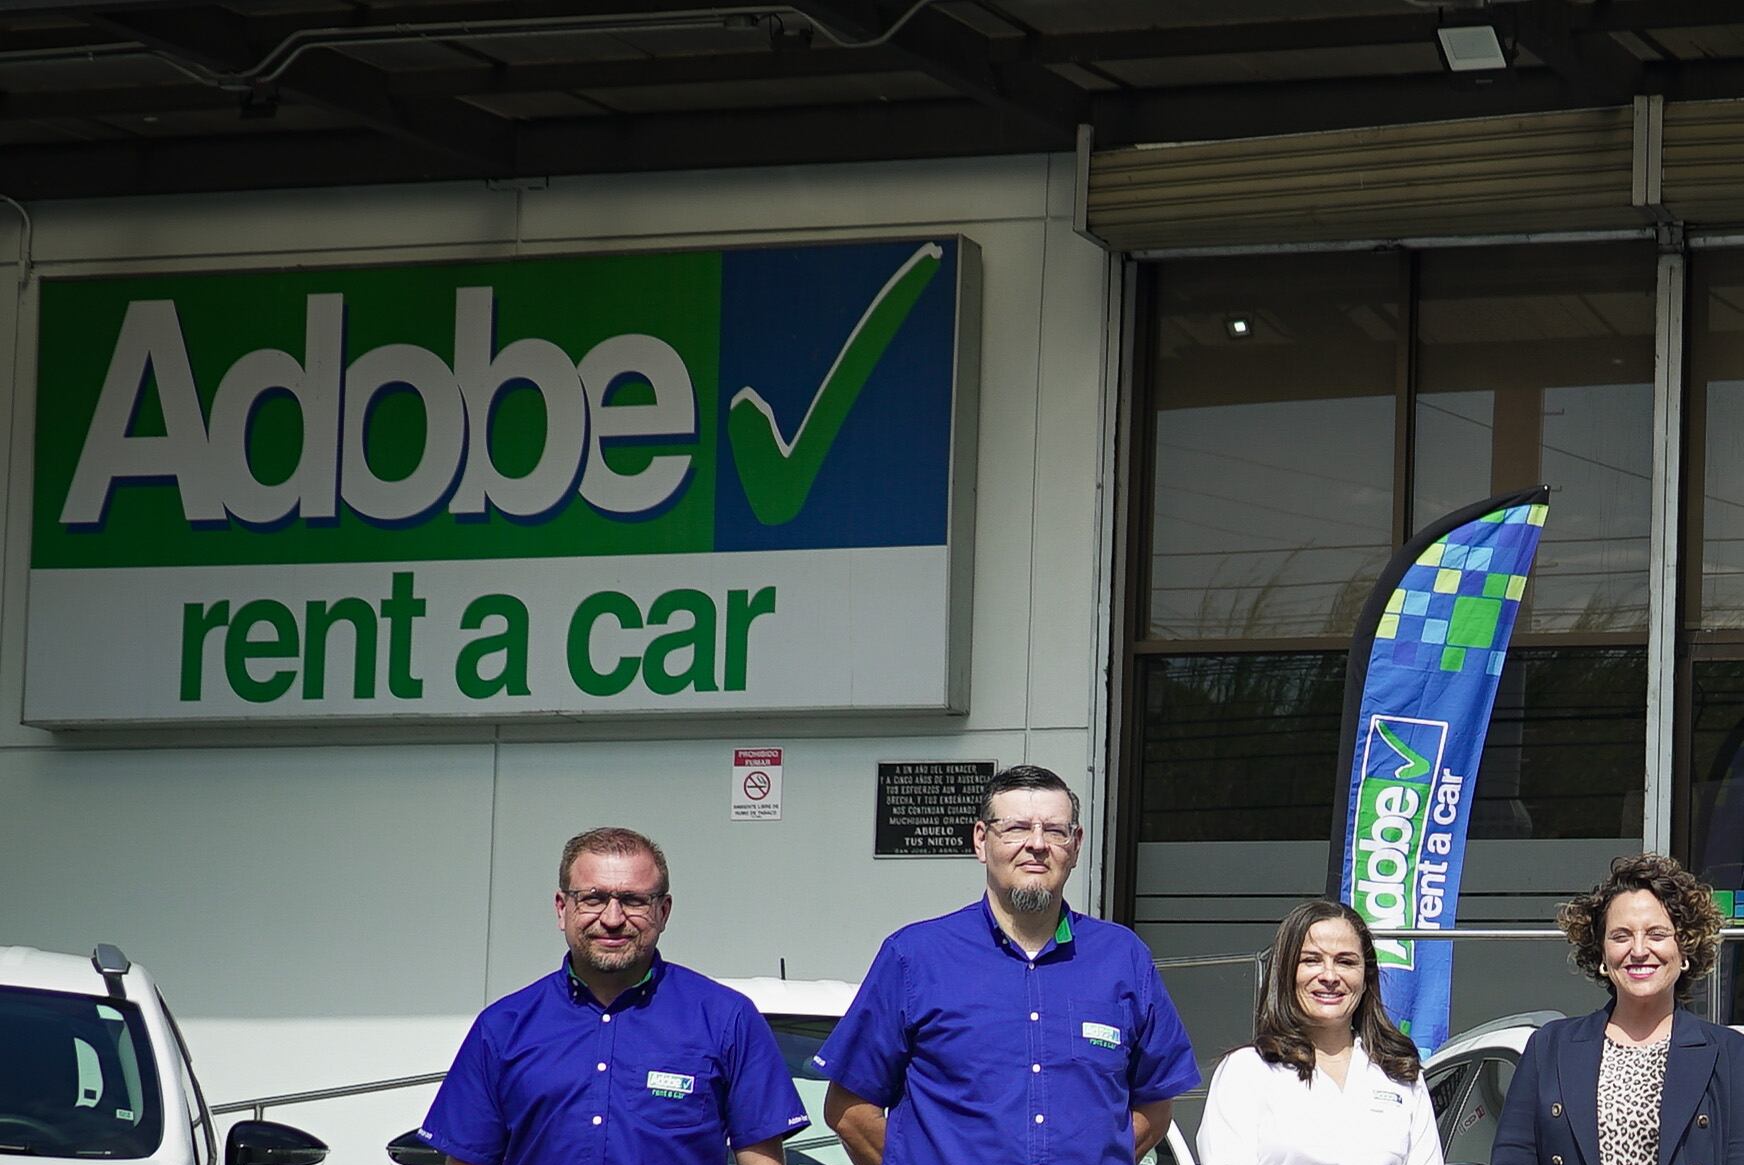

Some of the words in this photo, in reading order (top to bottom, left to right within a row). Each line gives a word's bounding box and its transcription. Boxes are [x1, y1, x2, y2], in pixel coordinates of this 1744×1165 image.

[59, 285, 697, 530] Adobe
[180, 571, 427, 703] rent
[455, 593, 532, 699] a
[566, 585, 776, 697] car
[893, 776, 913, 784] CINCO
[901, 785, 940, 794] ESFUERZOS
[1433, 768, 1463, 825] car
[924, 796, 937, 804] TUS
[915, 827, 954, 835] ABUELO
[904, 837, 923, 846] TUS
[928, 837, 963, 846] NIETOS
[1428, 833, 1452, 855] a
[1417, 858, 1448, 930] rent
